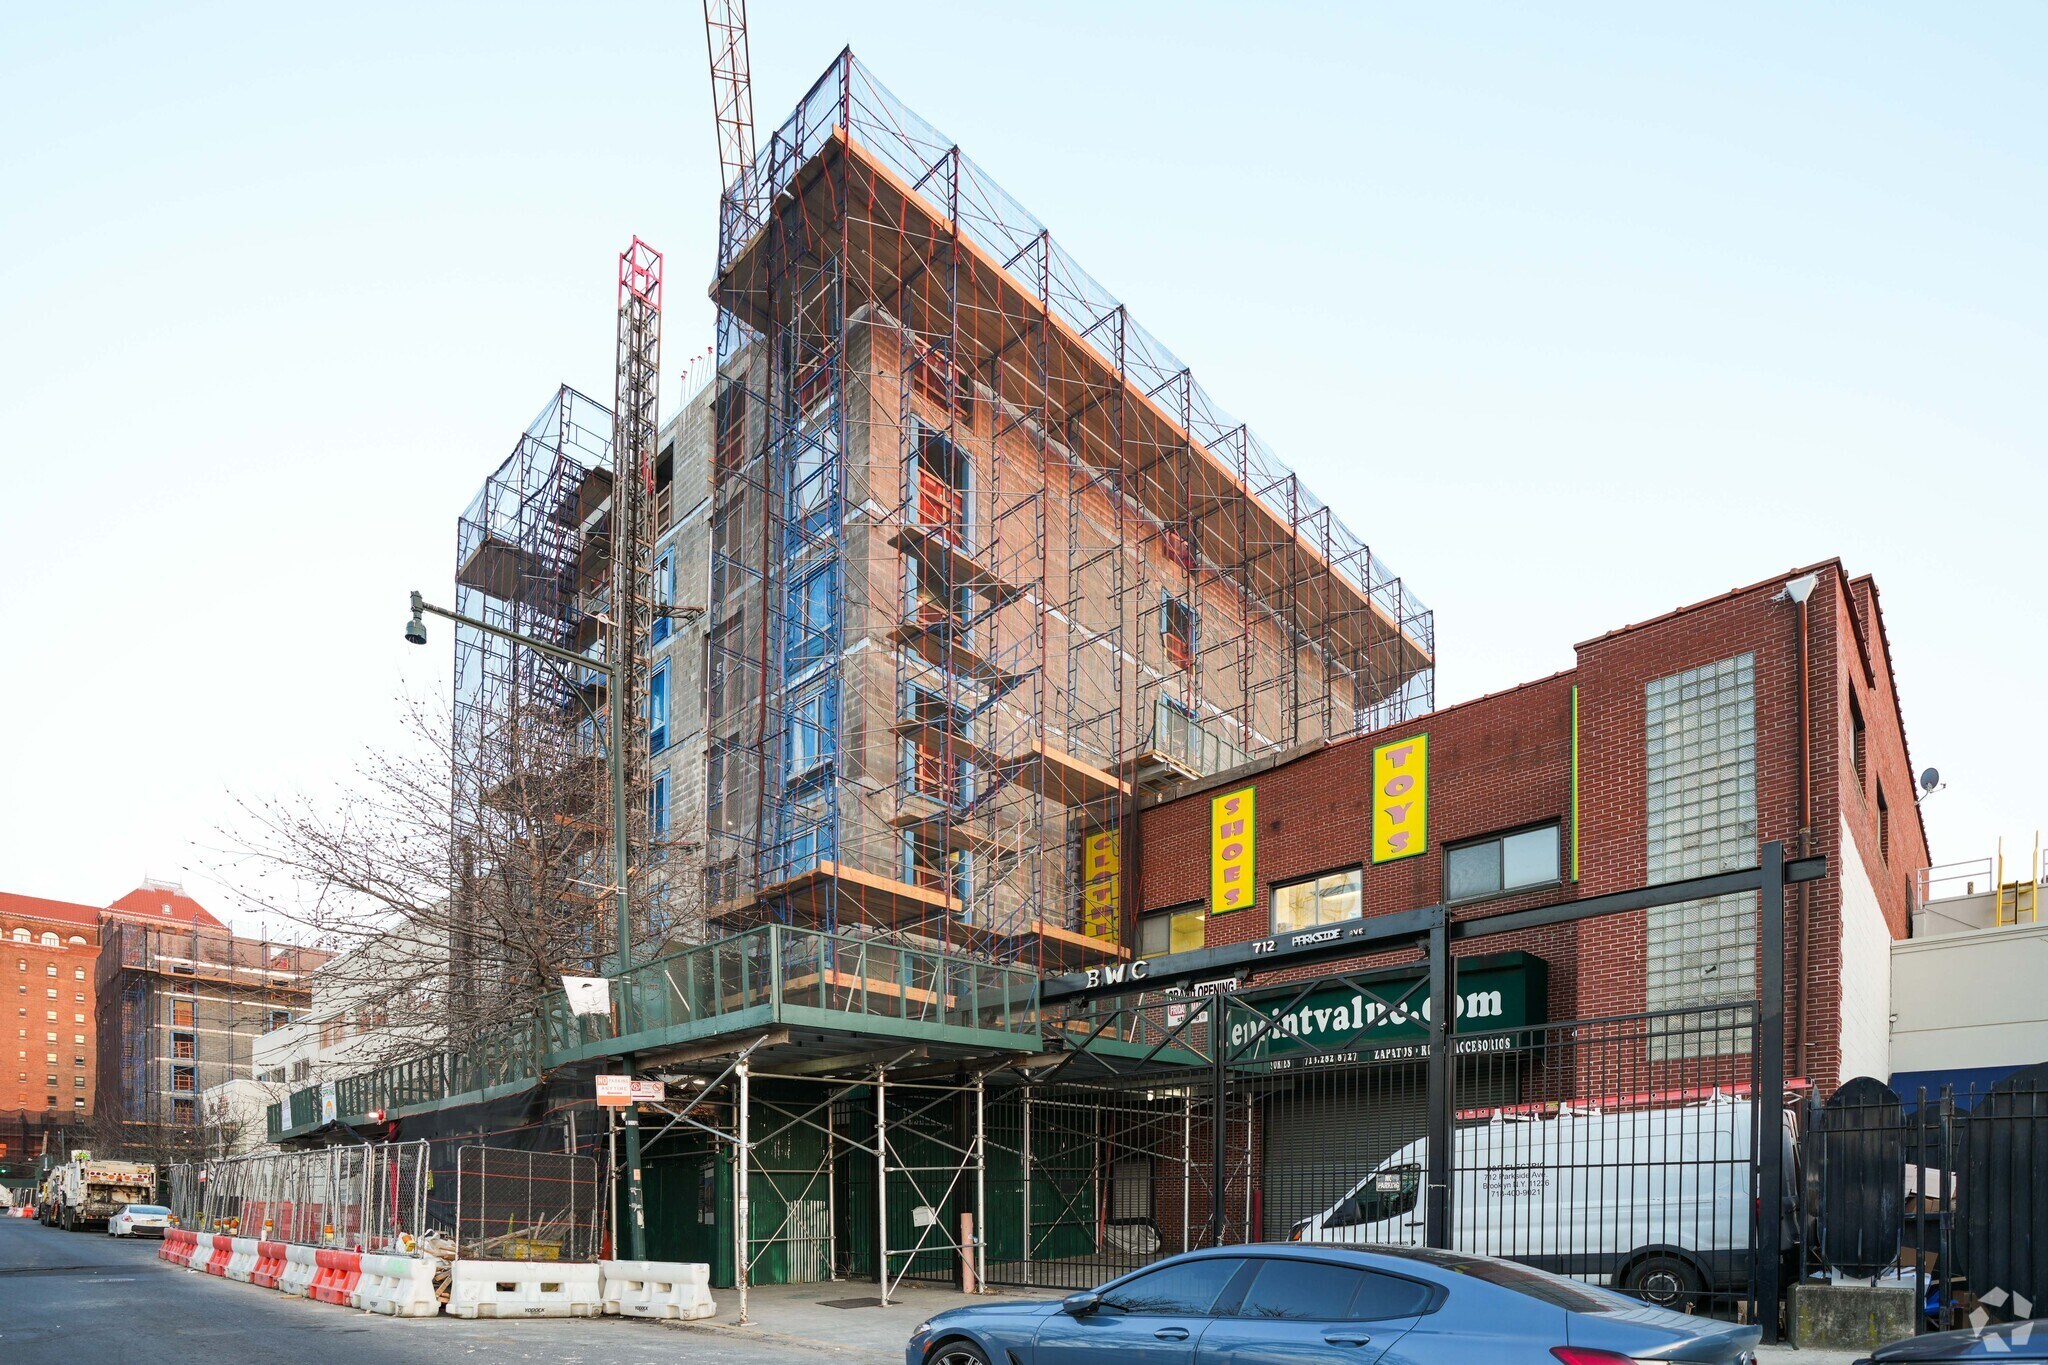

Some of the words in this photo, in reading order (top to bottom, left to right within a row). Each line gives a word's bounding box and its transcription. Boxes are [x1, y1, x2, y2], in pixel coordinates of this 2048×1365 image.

[1384, 745, 1414, 853] TOYS
[1221, 798, 1244, 905] SHOES
[1253, 941, 1275, 953] 712
[1292, 929, 1341, 946] PARKSIDE
[1198, 981, 1234, 997] OPENING
[1374, 1046, 1412, 1060] ZAPATOS
[598, 1077, 607, 1085] NO
[1483, 1182, 1511, 1190] Bookyn
